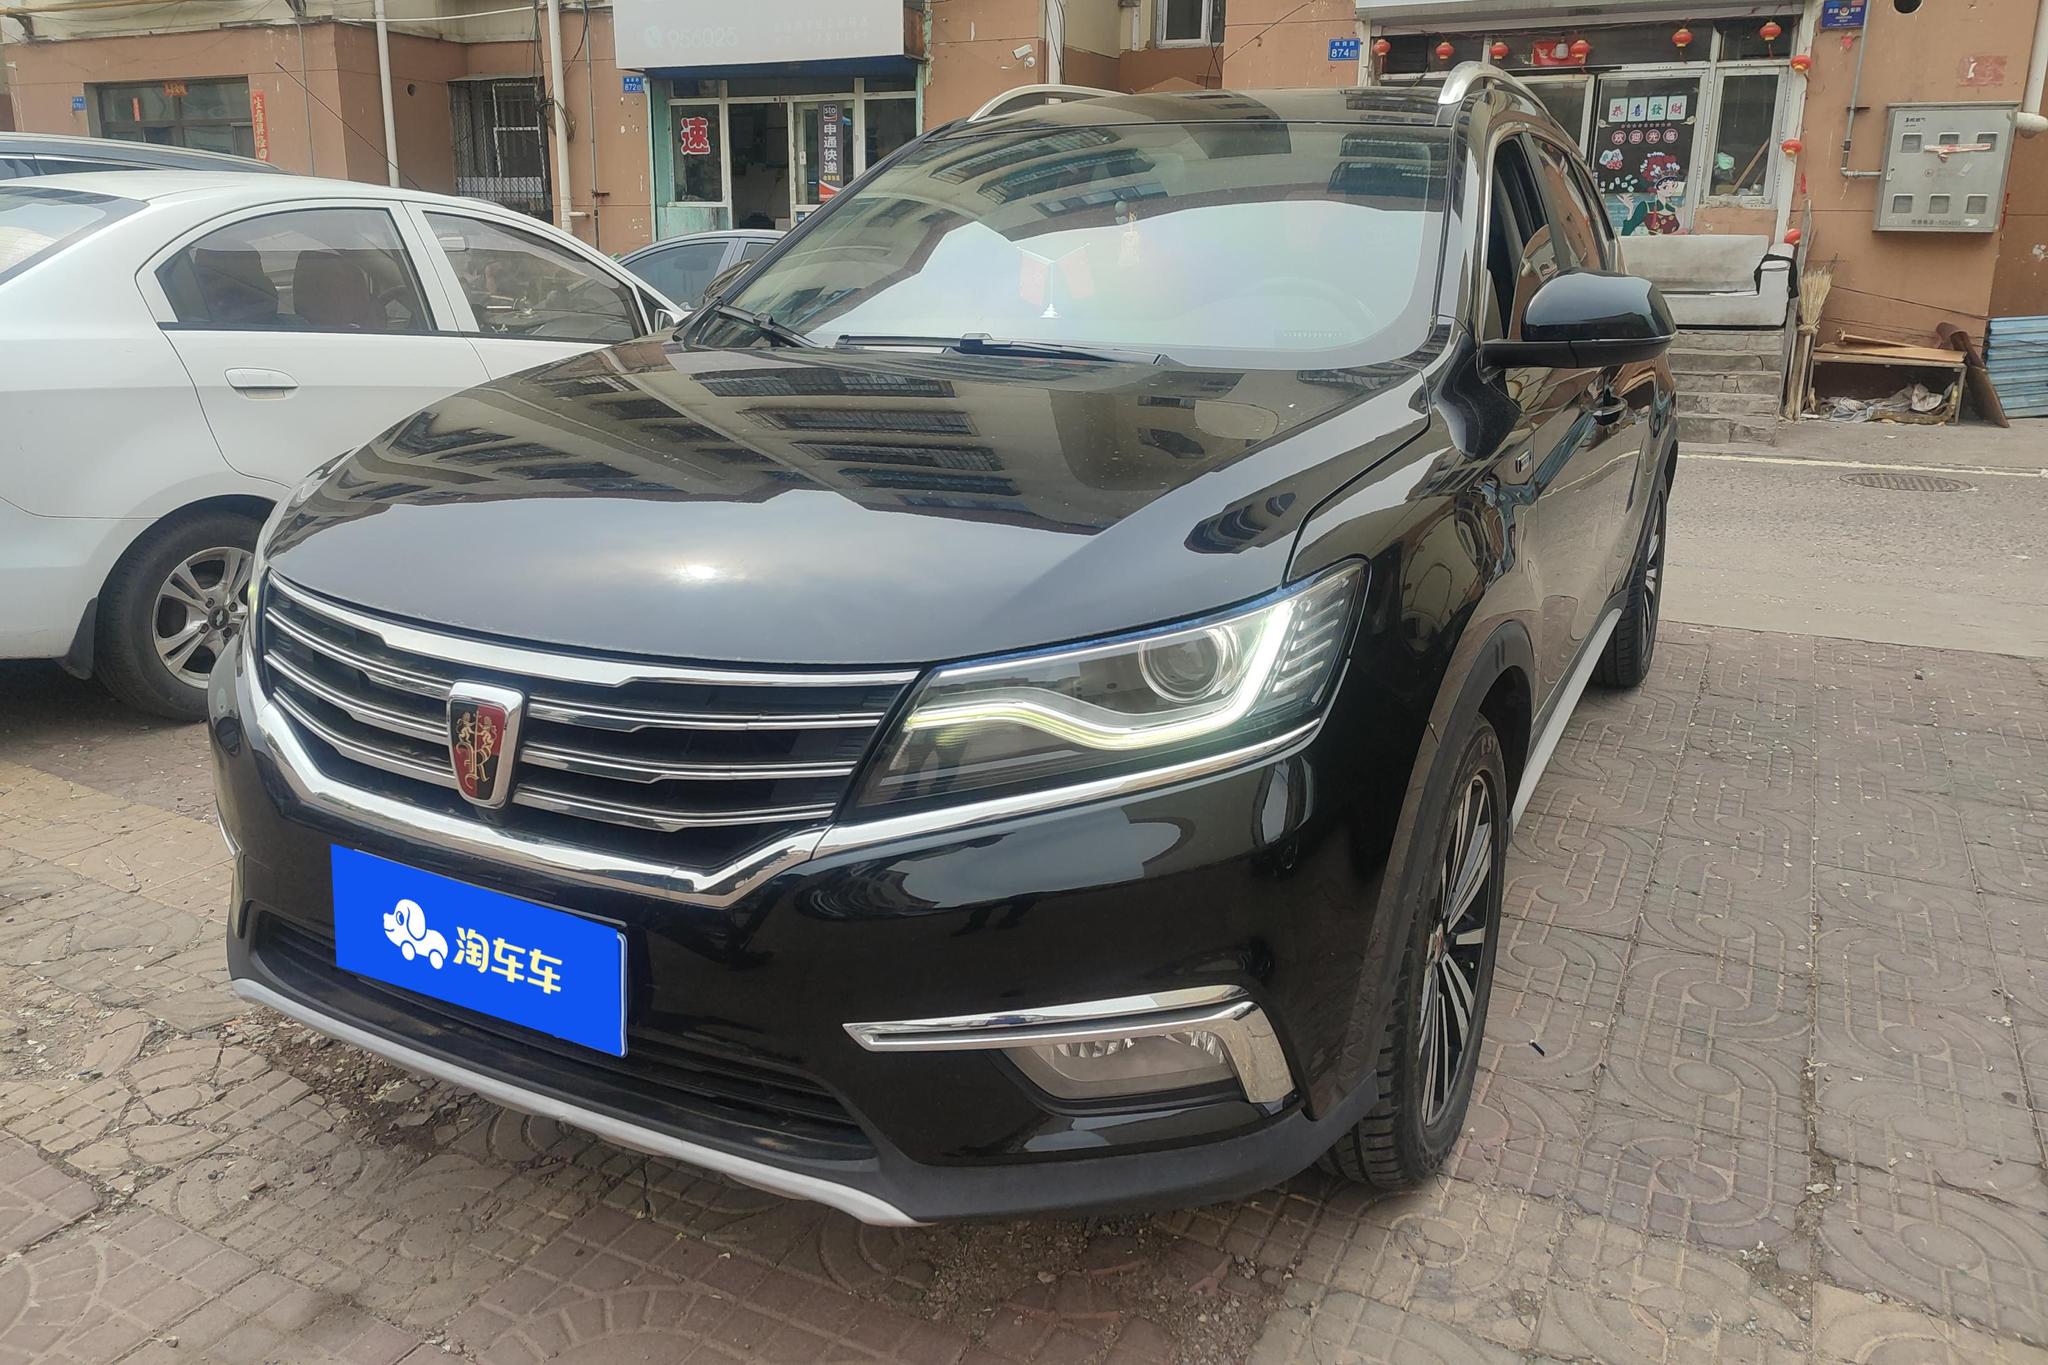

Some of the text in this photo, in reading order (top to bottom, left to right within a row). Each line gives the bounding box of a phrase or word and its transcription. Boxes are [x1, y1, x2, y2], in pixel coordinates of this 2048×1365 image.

[681, 116, 711, 155] 速
[823, 123, 838, 174] 申通快递
[1612, 130, 1678, 144] 欢迎光临
